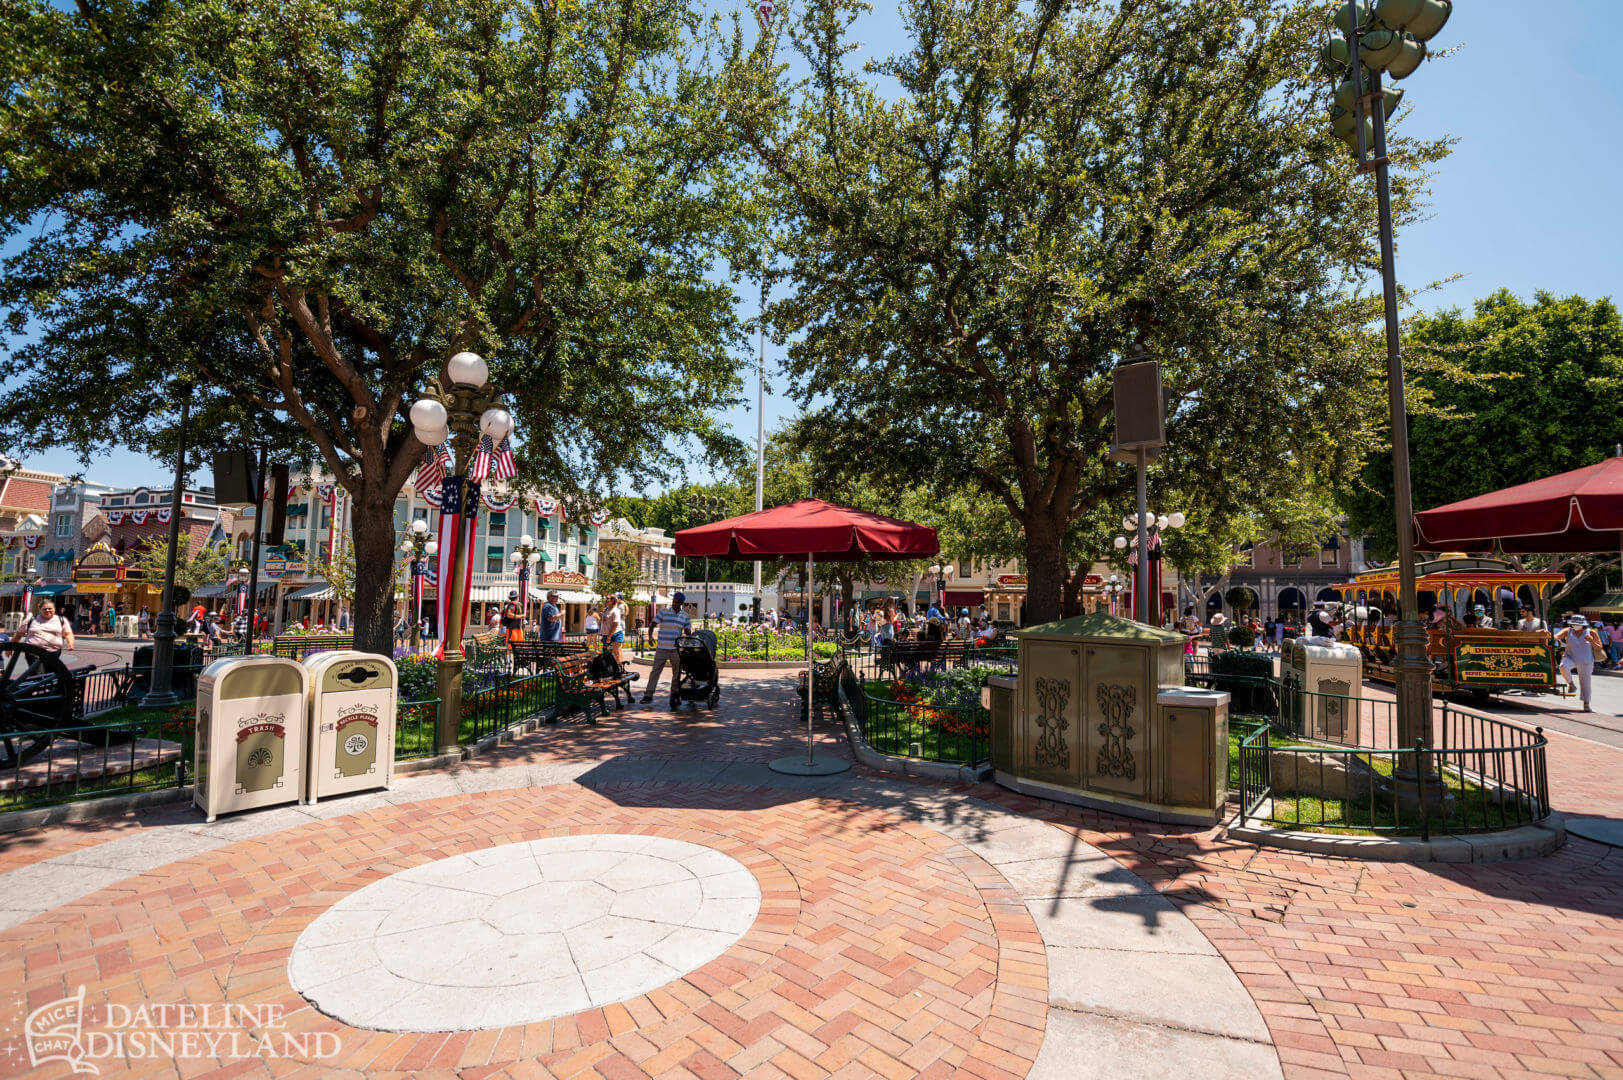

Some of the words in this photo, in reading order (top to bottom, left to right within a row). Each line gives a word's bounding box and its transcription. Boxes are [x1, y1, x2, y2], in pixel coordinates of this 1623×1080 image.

[1499, 658, 1508, 668] 3
[340, 715, 358, 725] RECYCLE
[359, 714, 376, 722] PLEASE
[247, 725, 275, 733] TRASH
